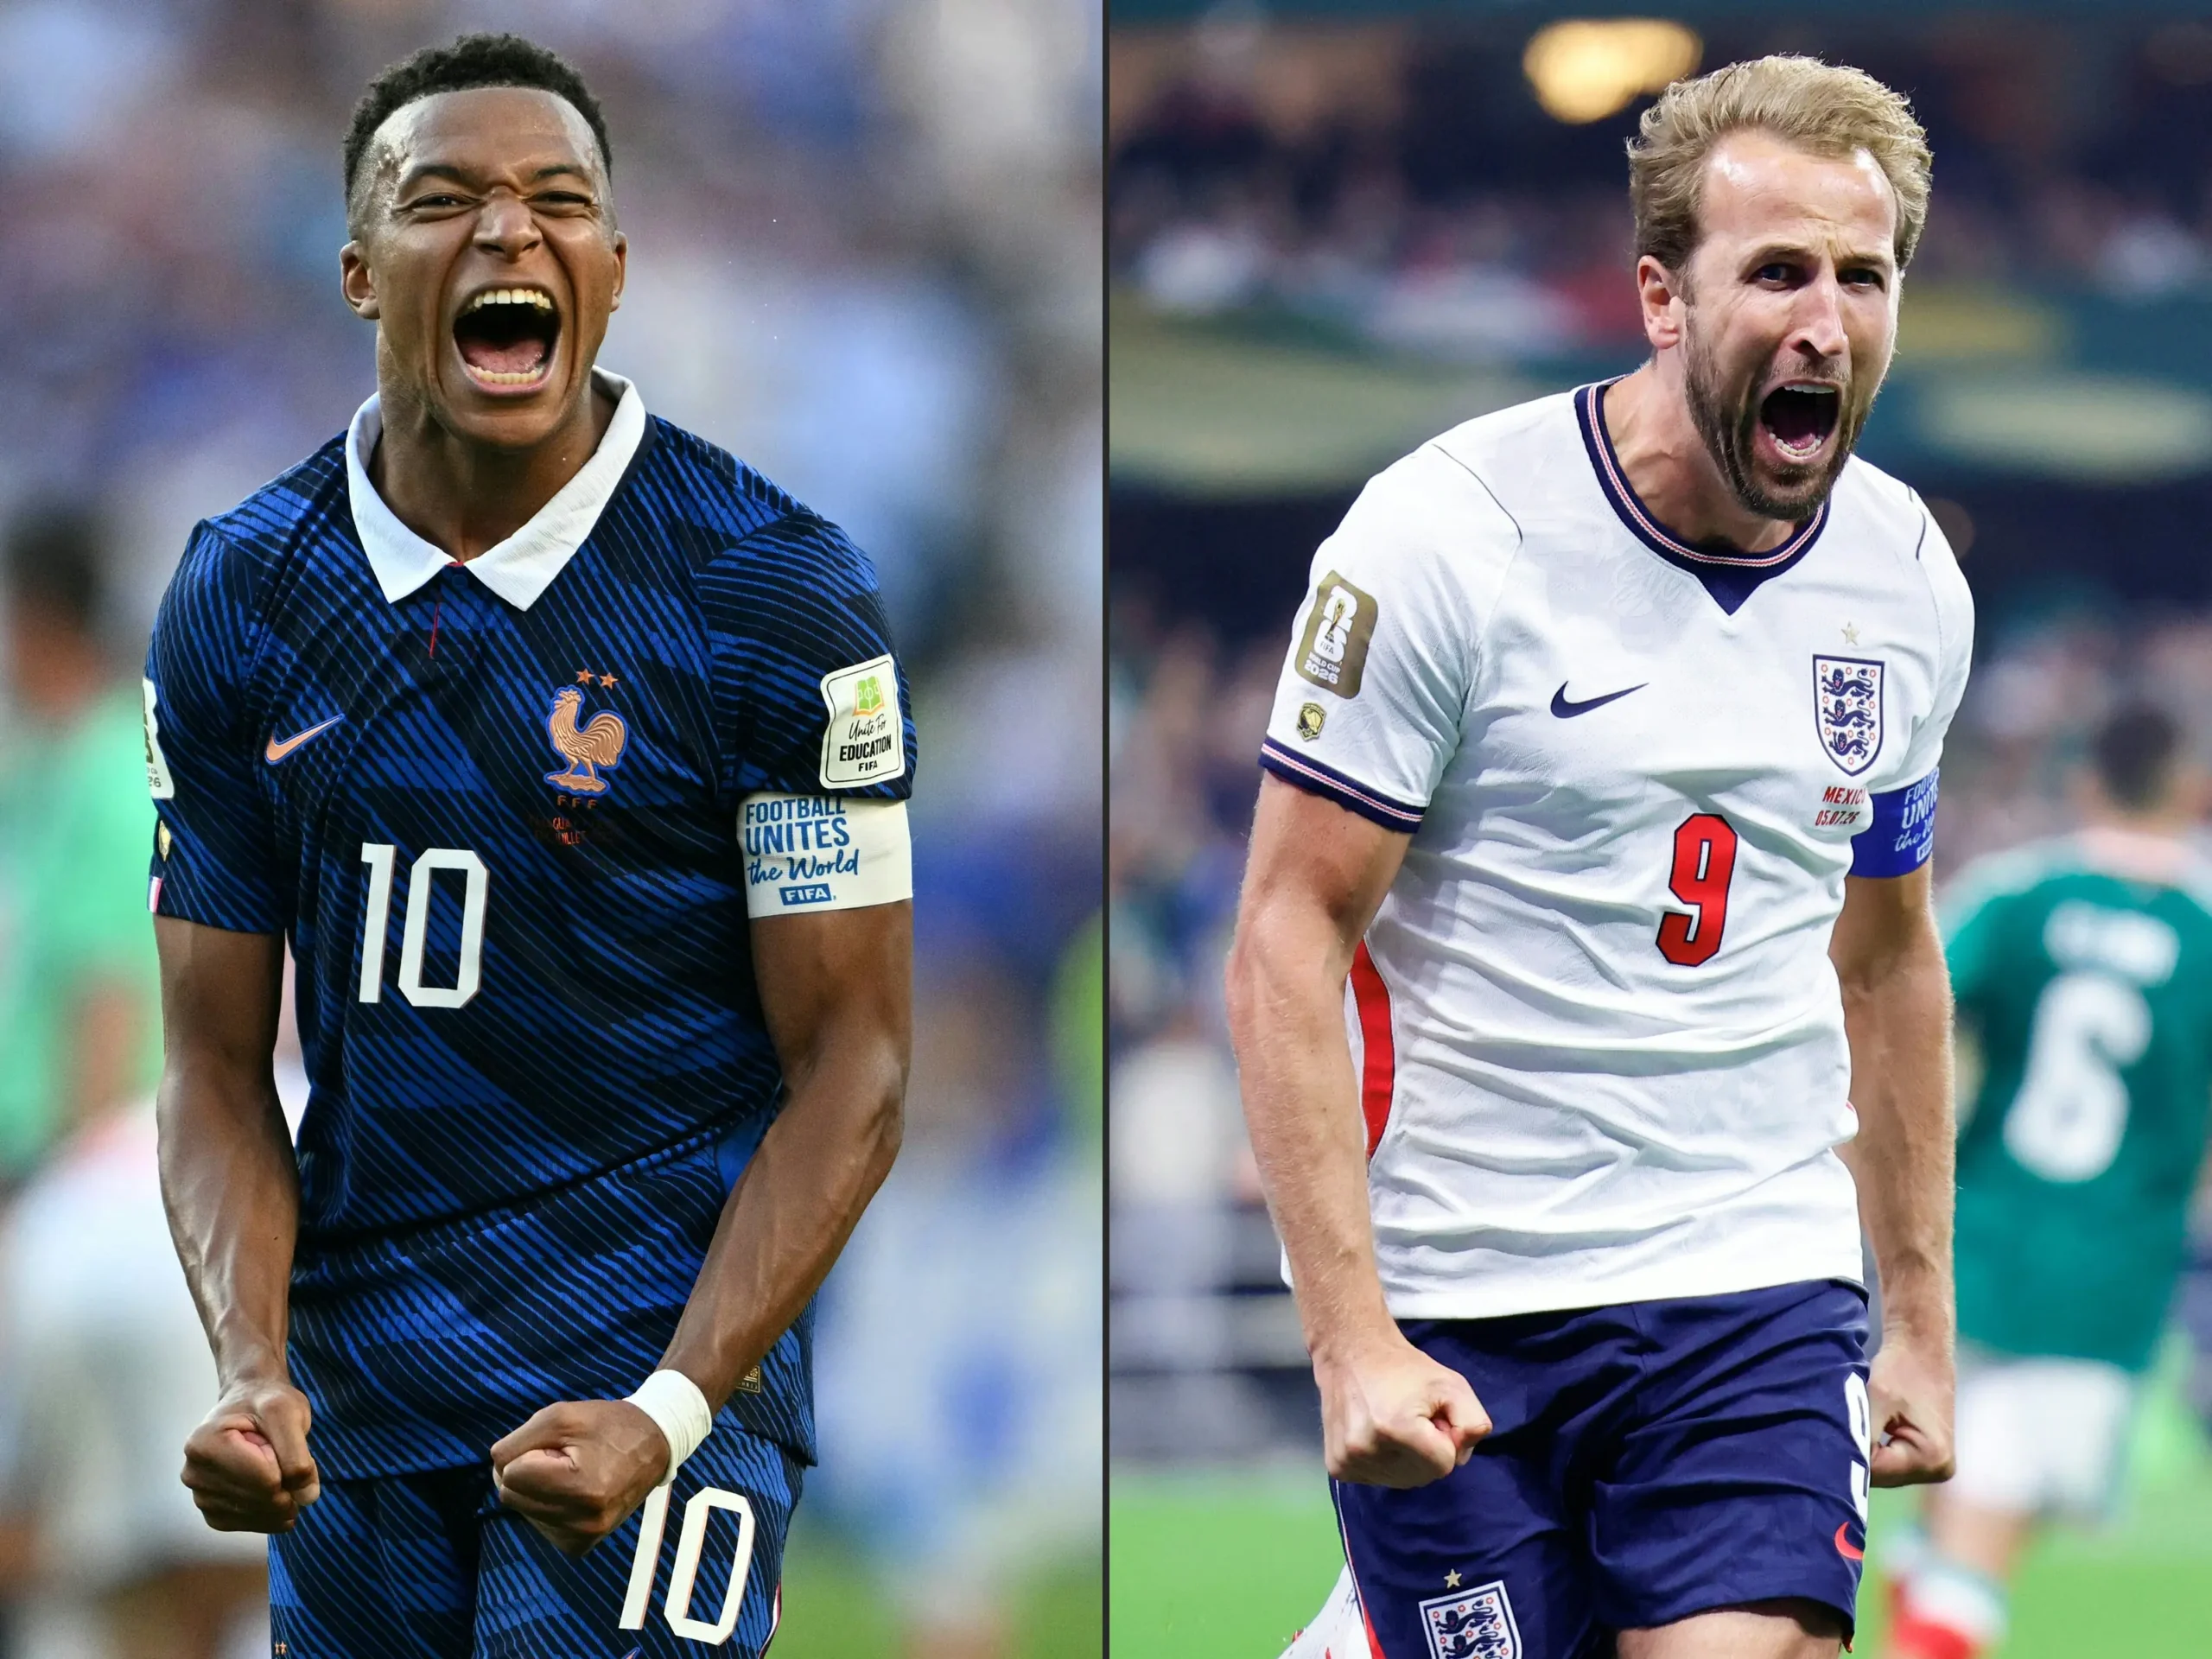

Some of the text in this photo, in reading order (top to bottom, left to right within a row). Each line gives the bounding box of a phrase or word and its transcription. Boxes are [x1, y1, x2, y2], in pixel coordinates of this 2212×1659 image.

[1304, 659, 1338, 685] 2026
[1327, 663, 1342, 674] CUP
[849, 713, 887, 741] Unite For
[839, 734, 892, 762] EDUCATION
[858, 760, 878, 772] FIFA
[745, 796, 846, 825] FOOTBALL
[1815, 810, 1861, 827] 05.07.26
[745, 817, 850, 856] UNITES
[747, 849, 860, 886] the World
[784, 888, 830, 903] FIFA
[1656, 812, 1738, 968] 9
[359, 842, 490, 1009] 10
[2003, 969, 2154, 1185] 6
[619, 1481, 756, 1646] 10
